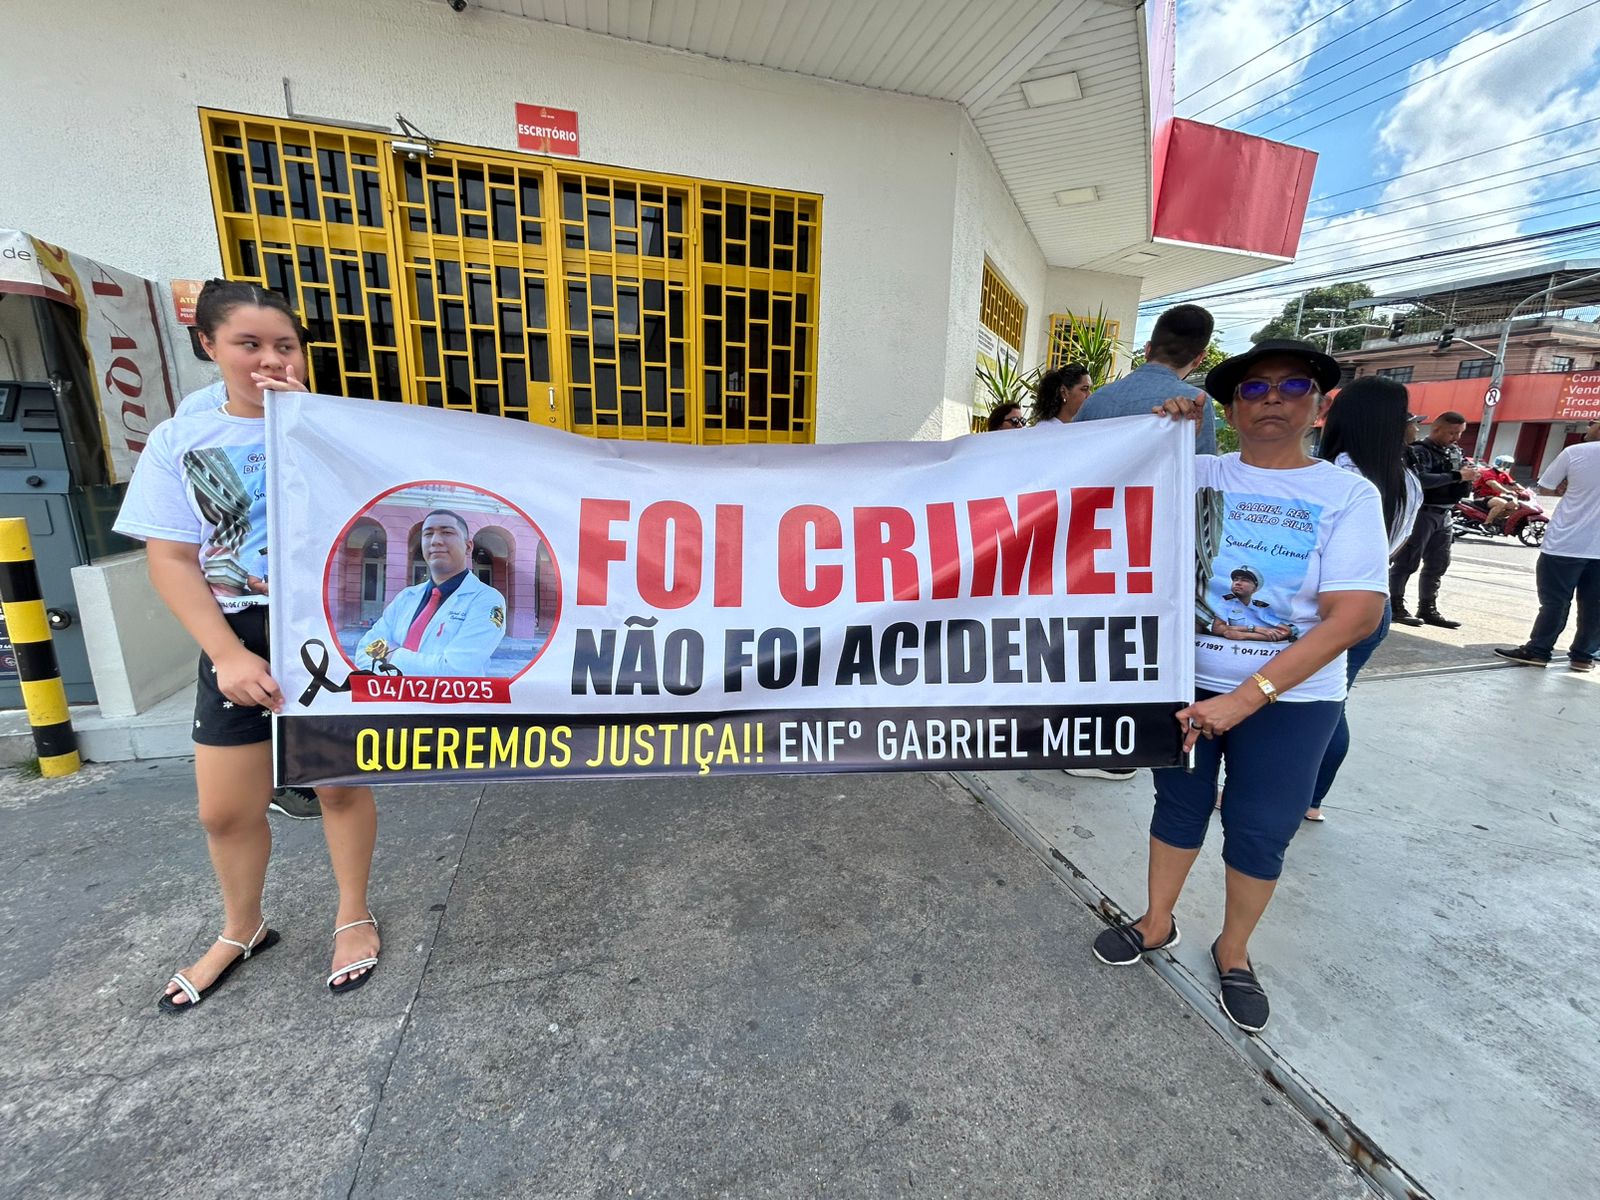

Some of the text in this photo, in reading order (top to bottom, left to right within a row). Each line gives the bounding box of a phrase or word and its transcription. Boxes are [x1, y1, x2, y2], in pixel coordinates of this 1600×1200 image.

[518, 123, 577, 142] ESCRITÓRIO
[1236, 502, 1282, 515] GABRIEL
[1228, 510, 1313, 533] DE MELO SILVA
[577, 486, 1154, 609] FOI CRIME!
[1225, 535, 1309, 560] Saudades Eternas!
[571, 615, 1159, 696] NÃO FOI ACIDENTE!
[367, 678, 493, 700] 04/12/2025
[356, 715, 1136, 775] QUEREMOS JUSTIÇA!! ENFº GABRIEL MELO
